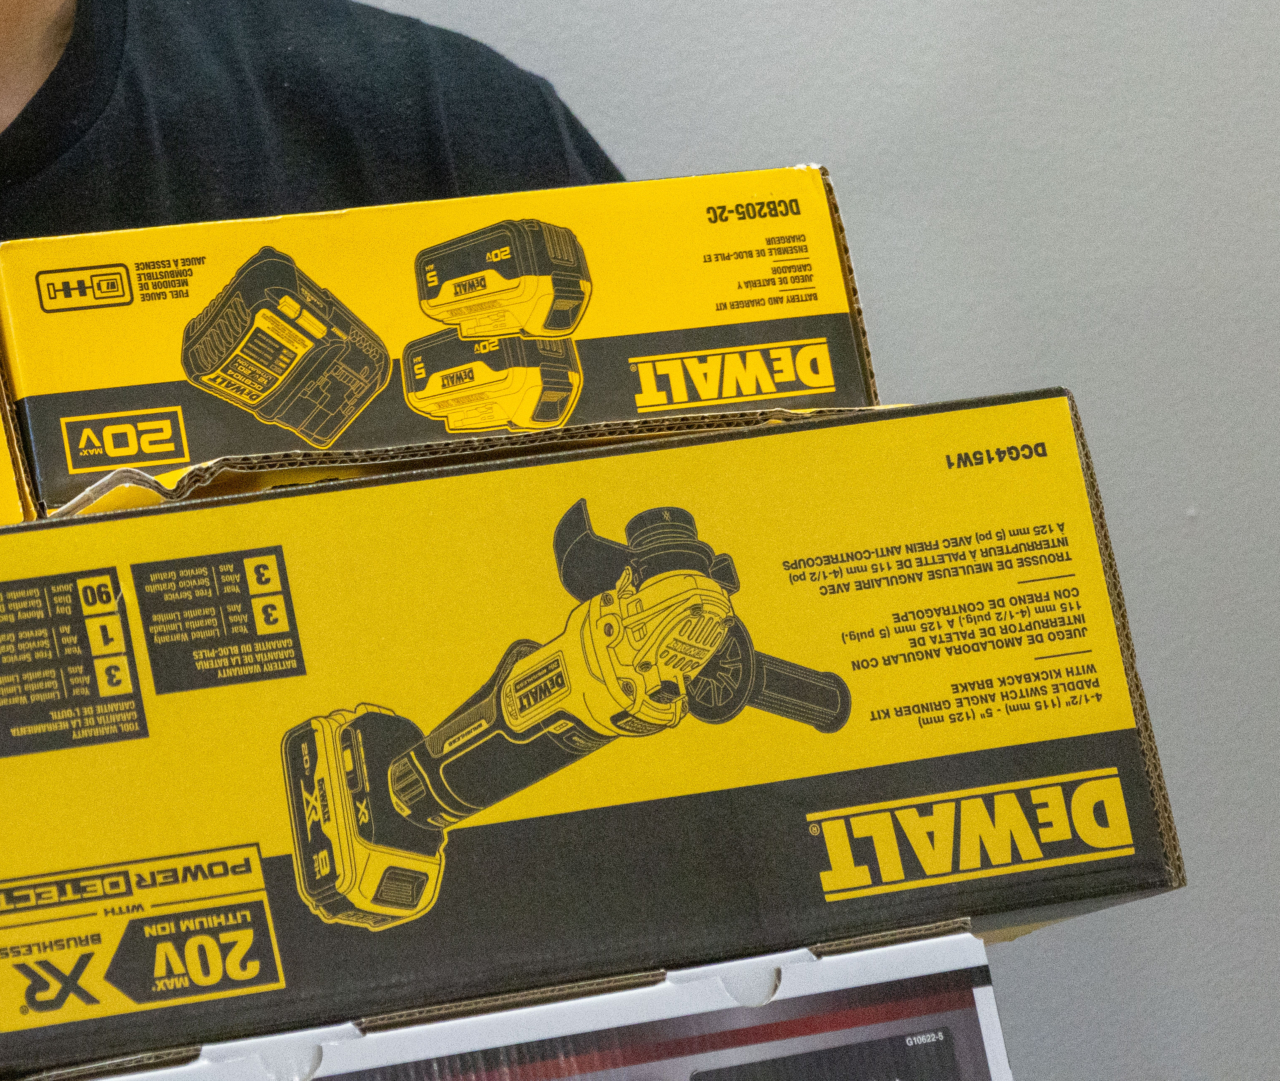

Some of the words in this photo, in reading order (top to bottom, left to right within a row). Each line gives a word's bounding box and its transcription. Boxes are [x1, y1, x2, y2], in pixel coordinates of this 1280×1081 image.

[705, 197, 801, 224] DCB205-2C
[764, 233, 806, 246] CHARGEUR
[712, 249, 754, 262] BLOC-PILE
[754, 247, 766, 258] DE
[766, 243, 809, 256] ENSEMBLE
[133, 258, 172, 271] ESSENCE
[171, 258, 179, 268] À
[179, 255, 206, 267] JAUGE
[702, 253, 713, 263] ET
[135, 267, 193, 282] COMBUSTIBLE
[770, 262, 812, 275] CARGADOR
[150, 277, 189, 290] MEDIDOR
[424, 270, 438, 287] 5
[736, 280, 743, 289] Y
[742, 276, 777, 289] BATERÍA
[776, 275, 789, 286] DE
[788, 272, 814, 284] JUEGO
[137, 281, 150, 291] DE
[168, 288, 189, 299] FUEL
[451, 275, 487, 297] DEWALT
[139, 290, 168, 302] GAUGE
[728, 297, 766, 310] CHARGER
[766, 295, 784, 306] AND
[785, 291, 818, 304] BATTERY
[714, 301, 728, 311] KIT
[412, 361, 426, 379] 5
[439, 366, 474, 389] DEWALT
[634, 343, 834, 407] DEWALT
[206, 373, 261, 401] DEWALT
[944, 441, 1048, 469] DCG415W1
[994, 528, 1006, 541] (5
[1007, 526, 1030, 537] mm
[1031, 523, 1054, 536] 125
[1055, 521, 1065, 533] À
[941, 534, 972, 549] AVEC
[974, 529, 993, 544] po)
[904, 538, 940, 554] FREIN
[978, 535, 1069, 558] INTERRUPTEUR
[781, 544, 902, 571] ANTI-CONTRECOUPS
[913, 550, 967, 568] PALETTE
[967, 548, 977, 562] À
[1015, 550, 1072, 568] TROUSSE
[844, 564, 868, 575] mm
[869, 561, 892, 573] 115
[894, 557, 913, 570] DE
[926, 561, 994, 581] MEULEUSE
[995, 558, 1014, 571] DE
[251, 562, 272, 586] 3
[788, 569, 807, 585] po)
[808, 565, 843, 582] (4-1/2
[853, 570, 923, 591] ANGULAIRE
[79, 581, 112, 607] 90
[818, 581, 851, 597] AVEC
[1052, 586, 1080, 600] CON
[987, 597, 1006, 610] DE
[1008, 590, 1050, 607] FRENO
[891, 600, 985, 624] CONTRAGOLPE
[993, 604, 1031, 622] (4-1/2
[1033, 603, 1057, 614] mm
[1058, 600, 1082, 613] 115
[259, 602, 280, 627] 3
[957, 610, 992, 627] pulg.)
[892, 623, 917, 635] mm
[919, 620, 942, 633] 125
[945, 617, 955, 629] A
[998, 612, 1086, 635] INTERRUPTOR
[98, 622, 115, 646] 1
[840, 627, 875, 645] pulg.)
[877, 624, 891, 639] (5
[928, 628, 976, 645] PALETA
[977, 625, 996, 638] DE
[1025, 632, 1044, 645] DE
[1046, 625, 1088, 642] JUEGO
[907, 635, 926, 648] DE
[943, 635, 1023, 656] AMOLADORA
[850, 656, 879, 671] CON
[880, 647, 941, 666] ANGULAR
[216, 663, 262, 678] WARRANTY
[262, 658, 297, 672] BATTERY
[1064, 662, 1097, 678] WITH
[102, 663, 124, 688] 3
[996, 667, 1062, 687] KICKBACK
[517, 674, 565, 710] DEWALT
[949, 677, 994, 694] BRAKE
[999, 684, 1048, 702] SWITCH
[1050, 677, 1100, 694] PADDLE
[954, 692, 996, 708] ANGLE
[1033, 695, 1061, 711] (115
[1064, 691, 1103, 707] 4-1/2"
[869, 707, 891, 722] KIT
[892, 698, 951, 717] GRINDER
[979, 707, 993, 719] 5"
[1004, 701, 1031, 715] mm)
[917, 714, 945, 729] mm)
[947, 707, 976, 724] (125
[819, 777, 1133, 891] DEWALT
[132, 856, 252, 890] POWER
[102, 901, 145, 918] WITH
[178, 908, 252, 932] LITHIUM
[142, 920, 176, 938] ION
[13, 952, 100, 1013] XR
